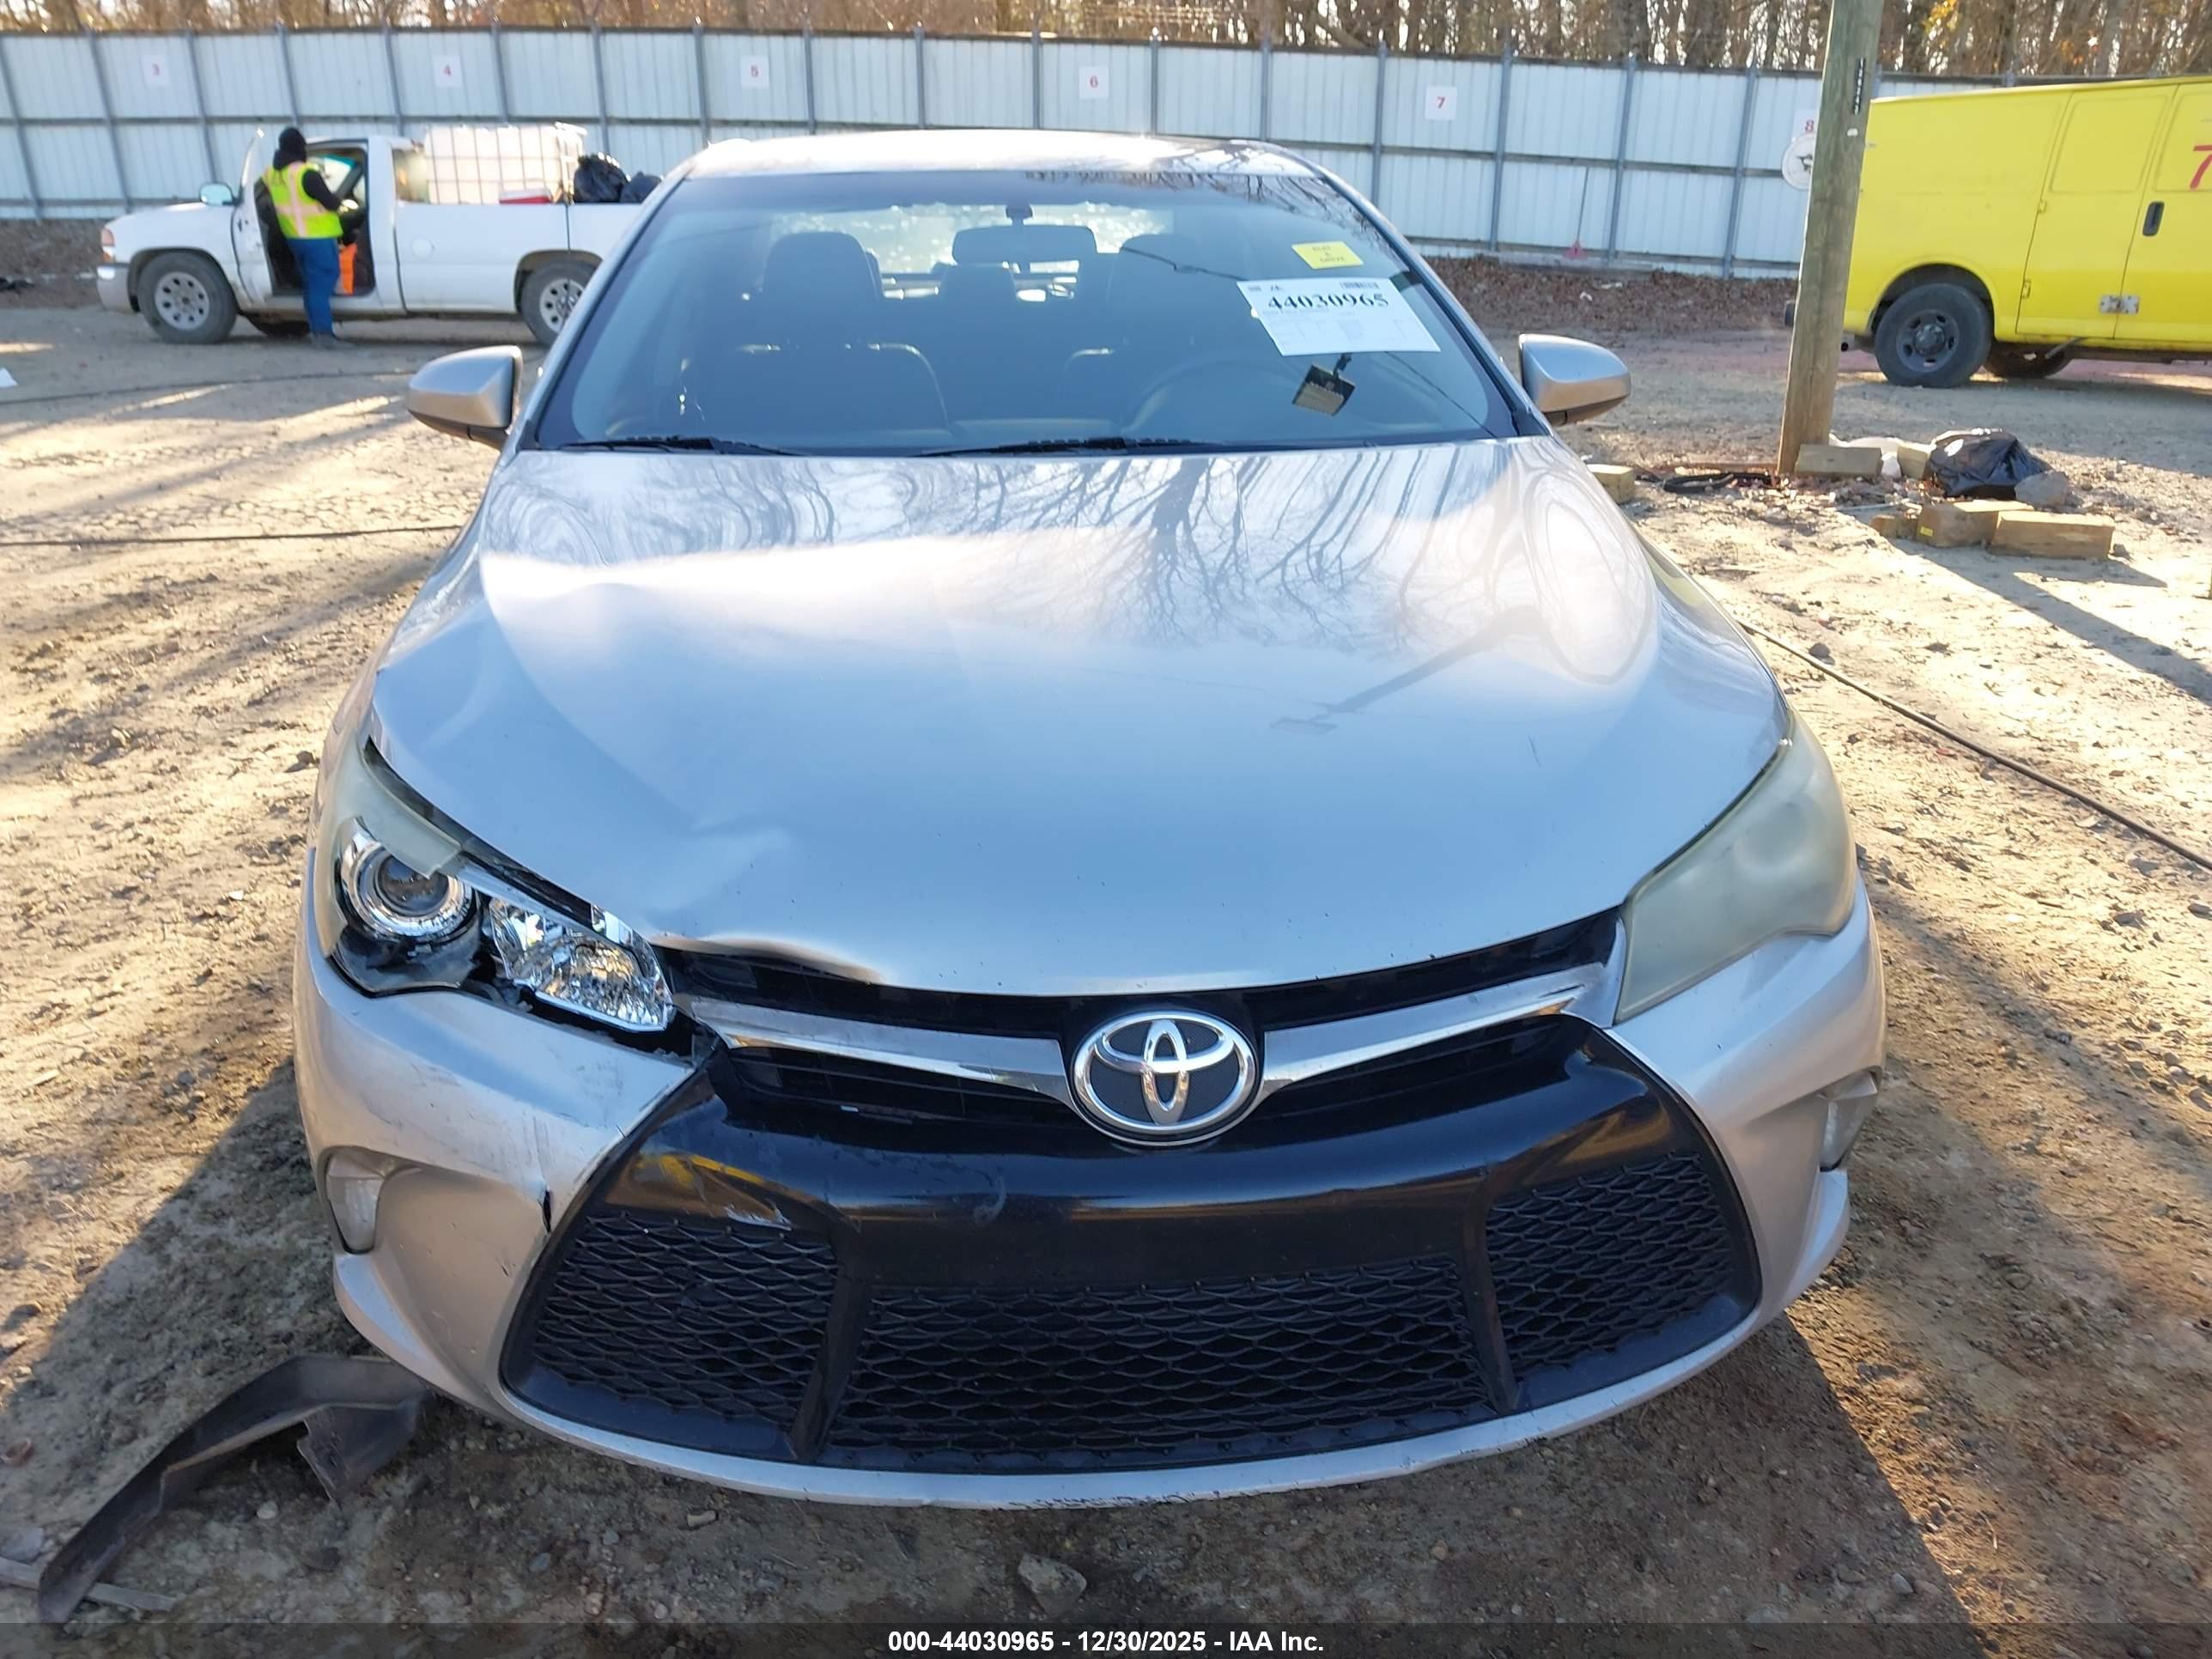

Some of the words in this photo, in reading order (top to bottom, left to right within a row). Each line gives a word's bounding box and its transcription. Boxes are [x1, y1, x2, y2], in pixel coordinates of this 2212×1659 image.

[152, 63, 161, 76] 3
[443, 64, 452, 76] 4
[1436, 96, 1446, 109] 7
[1805, 119, 1814, 131] 8
[1268, 293, 1389, 309] 44030965
